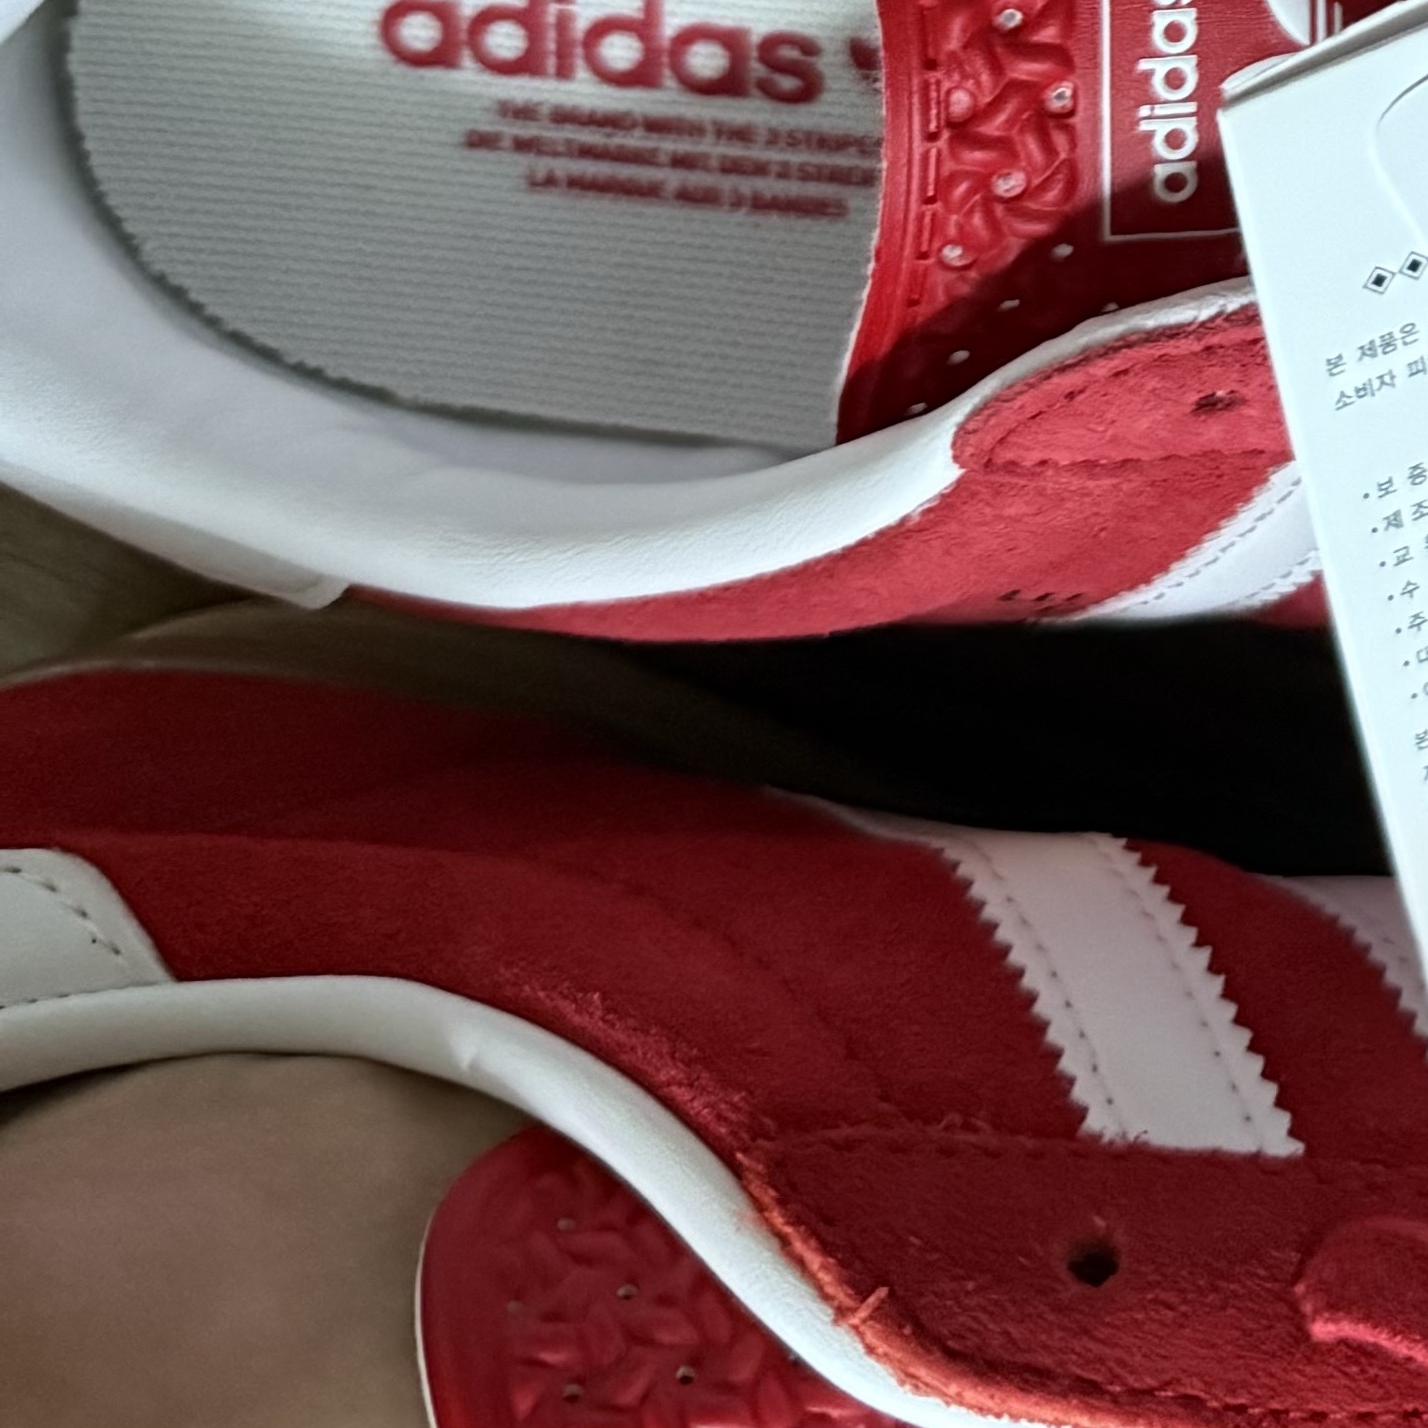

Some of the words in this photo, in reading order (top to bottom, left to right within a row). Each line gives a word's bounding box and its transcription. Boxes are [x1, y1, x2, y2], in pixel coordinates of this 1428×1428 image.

[1326, 354, 1346, 377] 본
[1358, 323, 1418, 361] 제품은
[1336, 370, 1395, 410] 소비자
